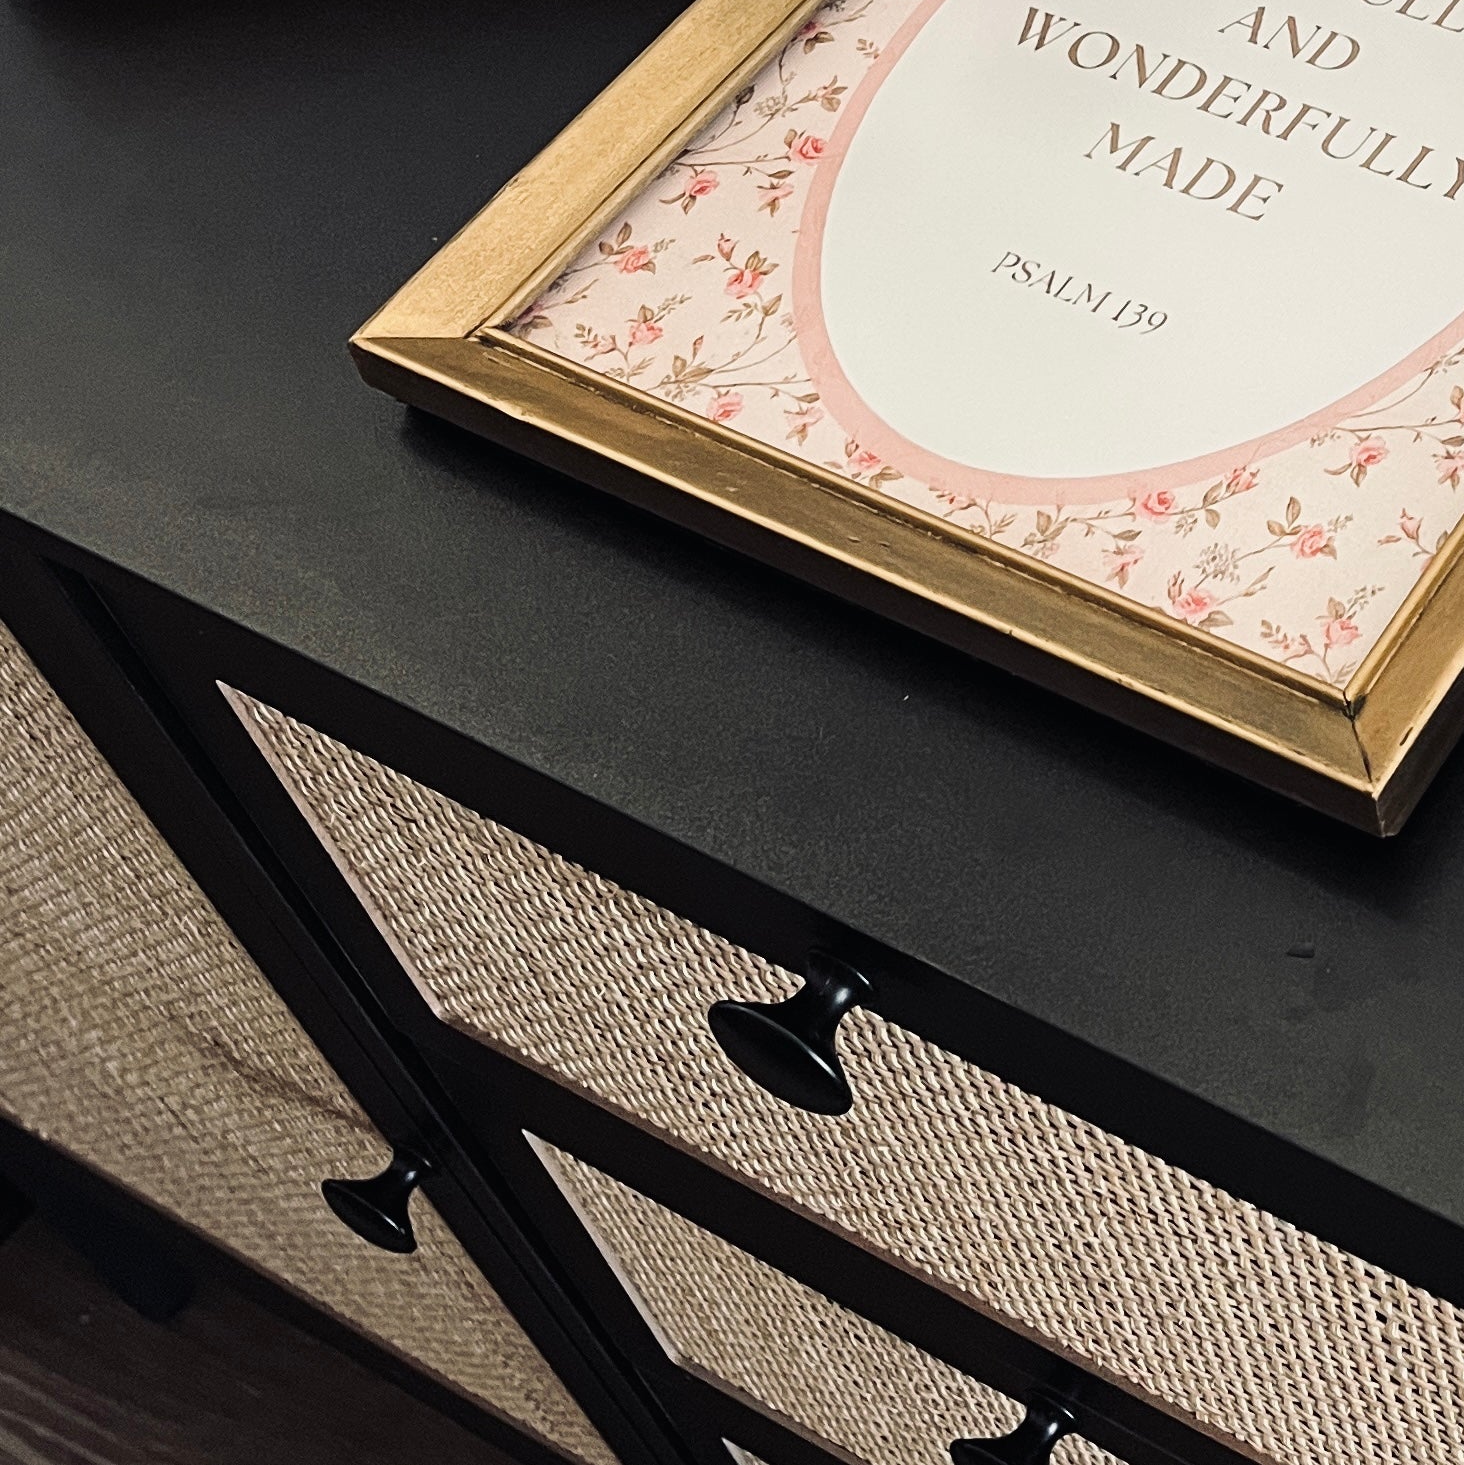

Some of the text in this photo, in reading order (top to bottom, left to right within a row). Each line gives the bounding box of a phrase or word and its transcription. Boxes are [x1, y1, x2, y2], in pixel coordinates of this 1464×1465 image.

[1217, 5, 1361, 71] AND
[1082, 121, 1285, 222] MADE
[990, 251, 1168, 335] PSALM 139
